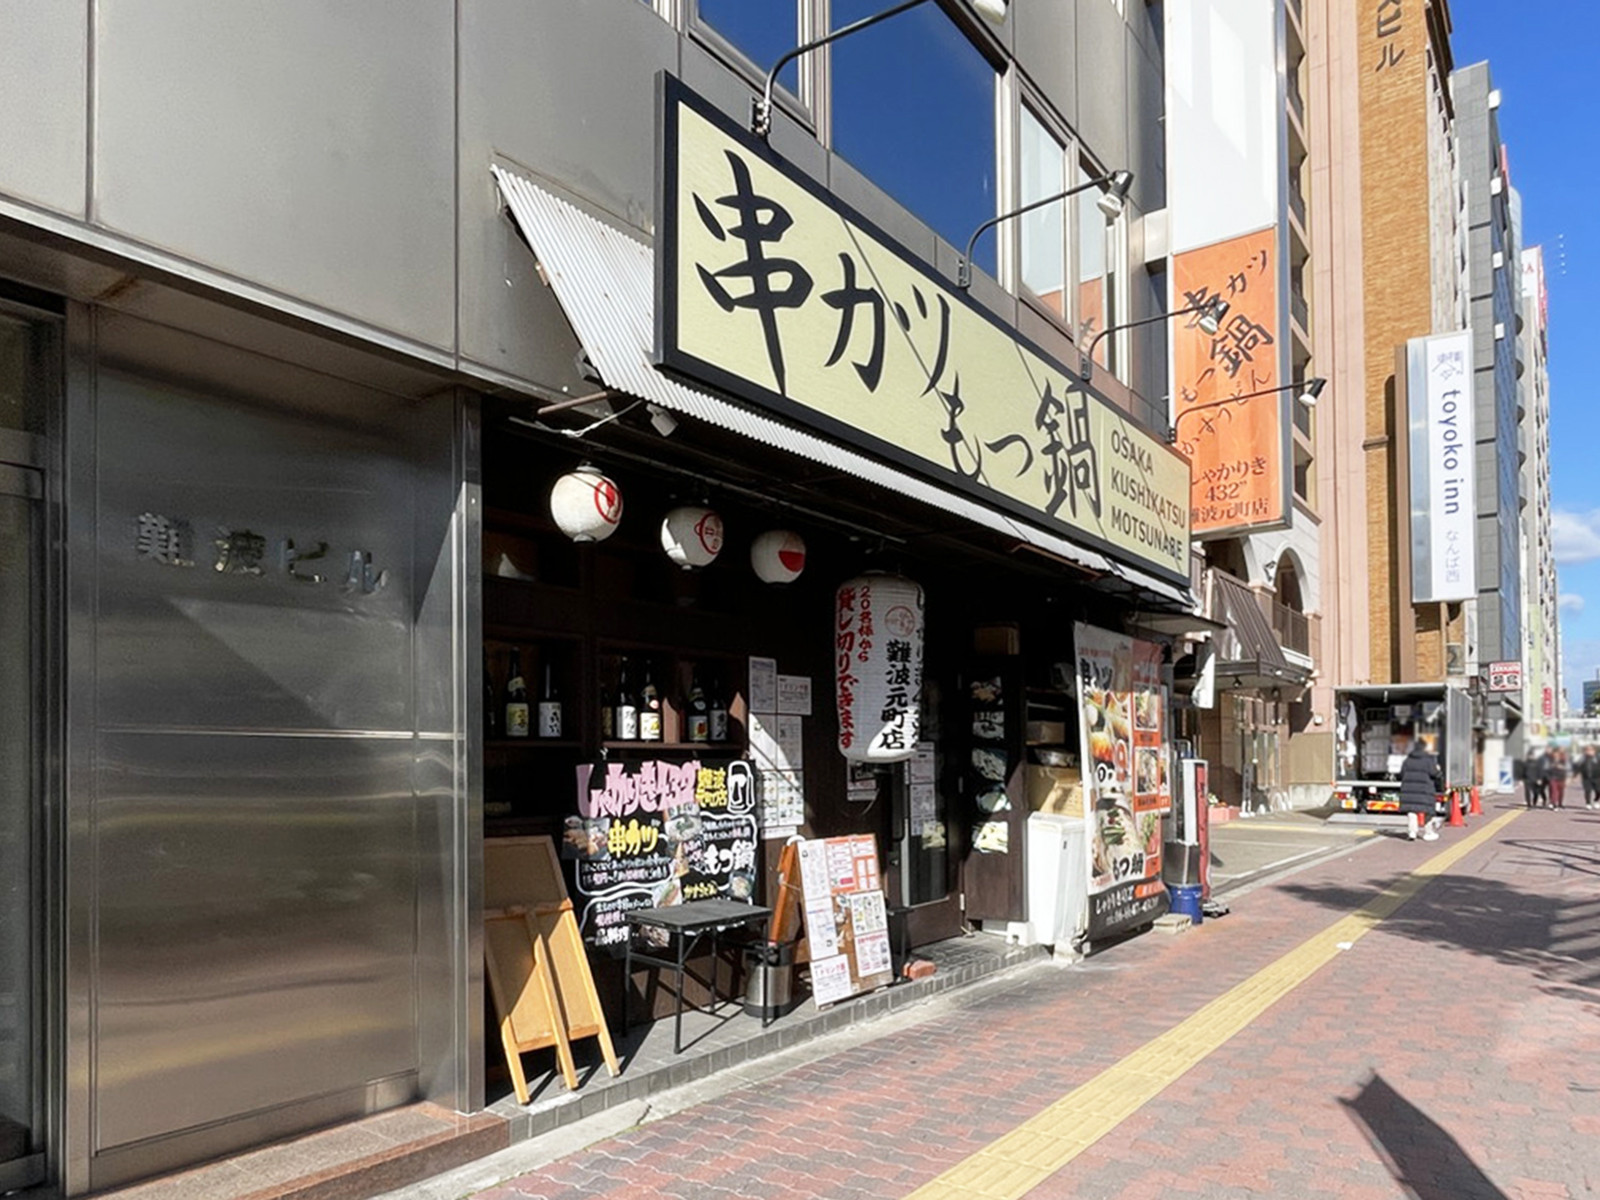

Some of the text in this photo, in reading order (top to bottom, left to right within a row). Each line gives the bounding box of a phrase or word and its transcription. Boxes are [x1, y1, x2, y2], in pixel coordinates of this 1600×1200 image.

[692, 149, 950, 398] 串カツ
[1181, 314, 1273, 402] もつ鍋
[941, 370, 1102, 520] もつ鍋
[1111, 430, 1154, 475] OSAKA
[1438, 389, 1464, 515] toyoko inn
[1111, 467, 1185, 528] KUSHIKATSU
[1111, 505, 1183, 561] MOTSUNABE
[879, 639, 913, 750] 難波元町店
